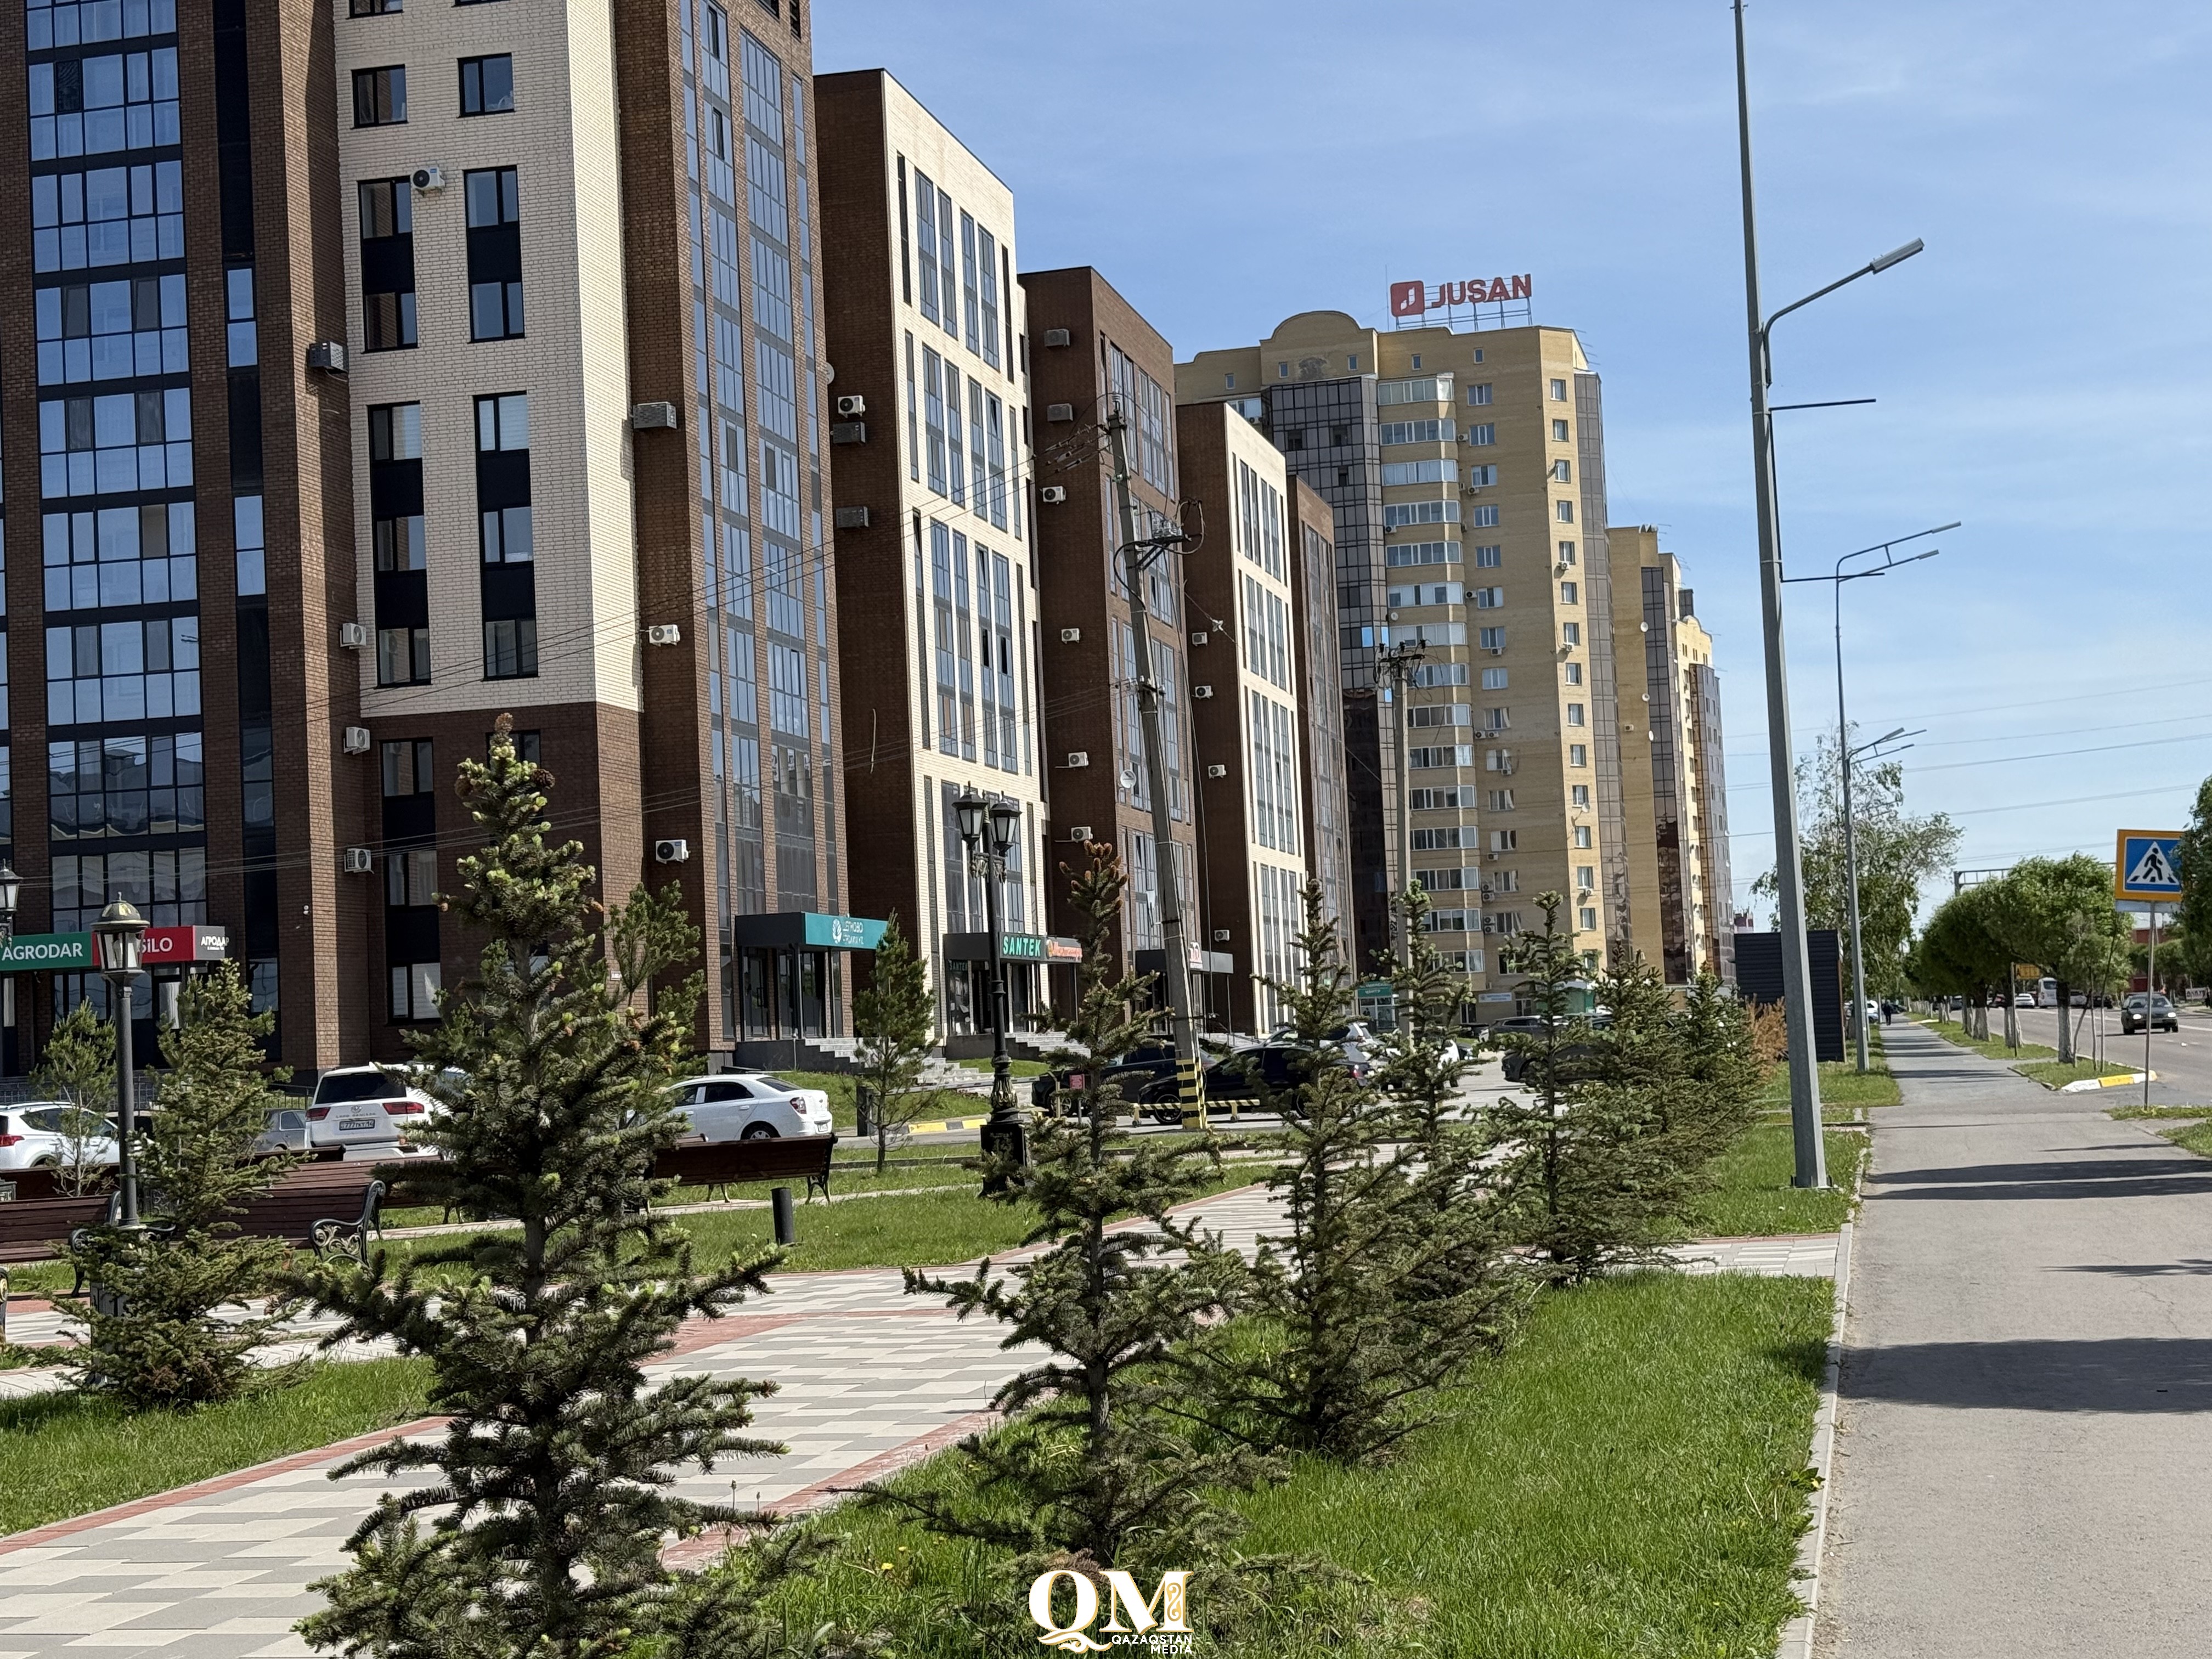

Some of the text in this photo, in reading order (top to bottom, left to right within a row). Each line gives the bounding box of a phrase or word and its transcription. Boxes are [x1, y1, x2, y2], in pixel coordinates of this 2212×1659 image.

[1431, 274, 1532, 308] JUSAN
[2, 943, 83, 960] AGRODAR
[1003, 936, 1041, 957] SANTEK
